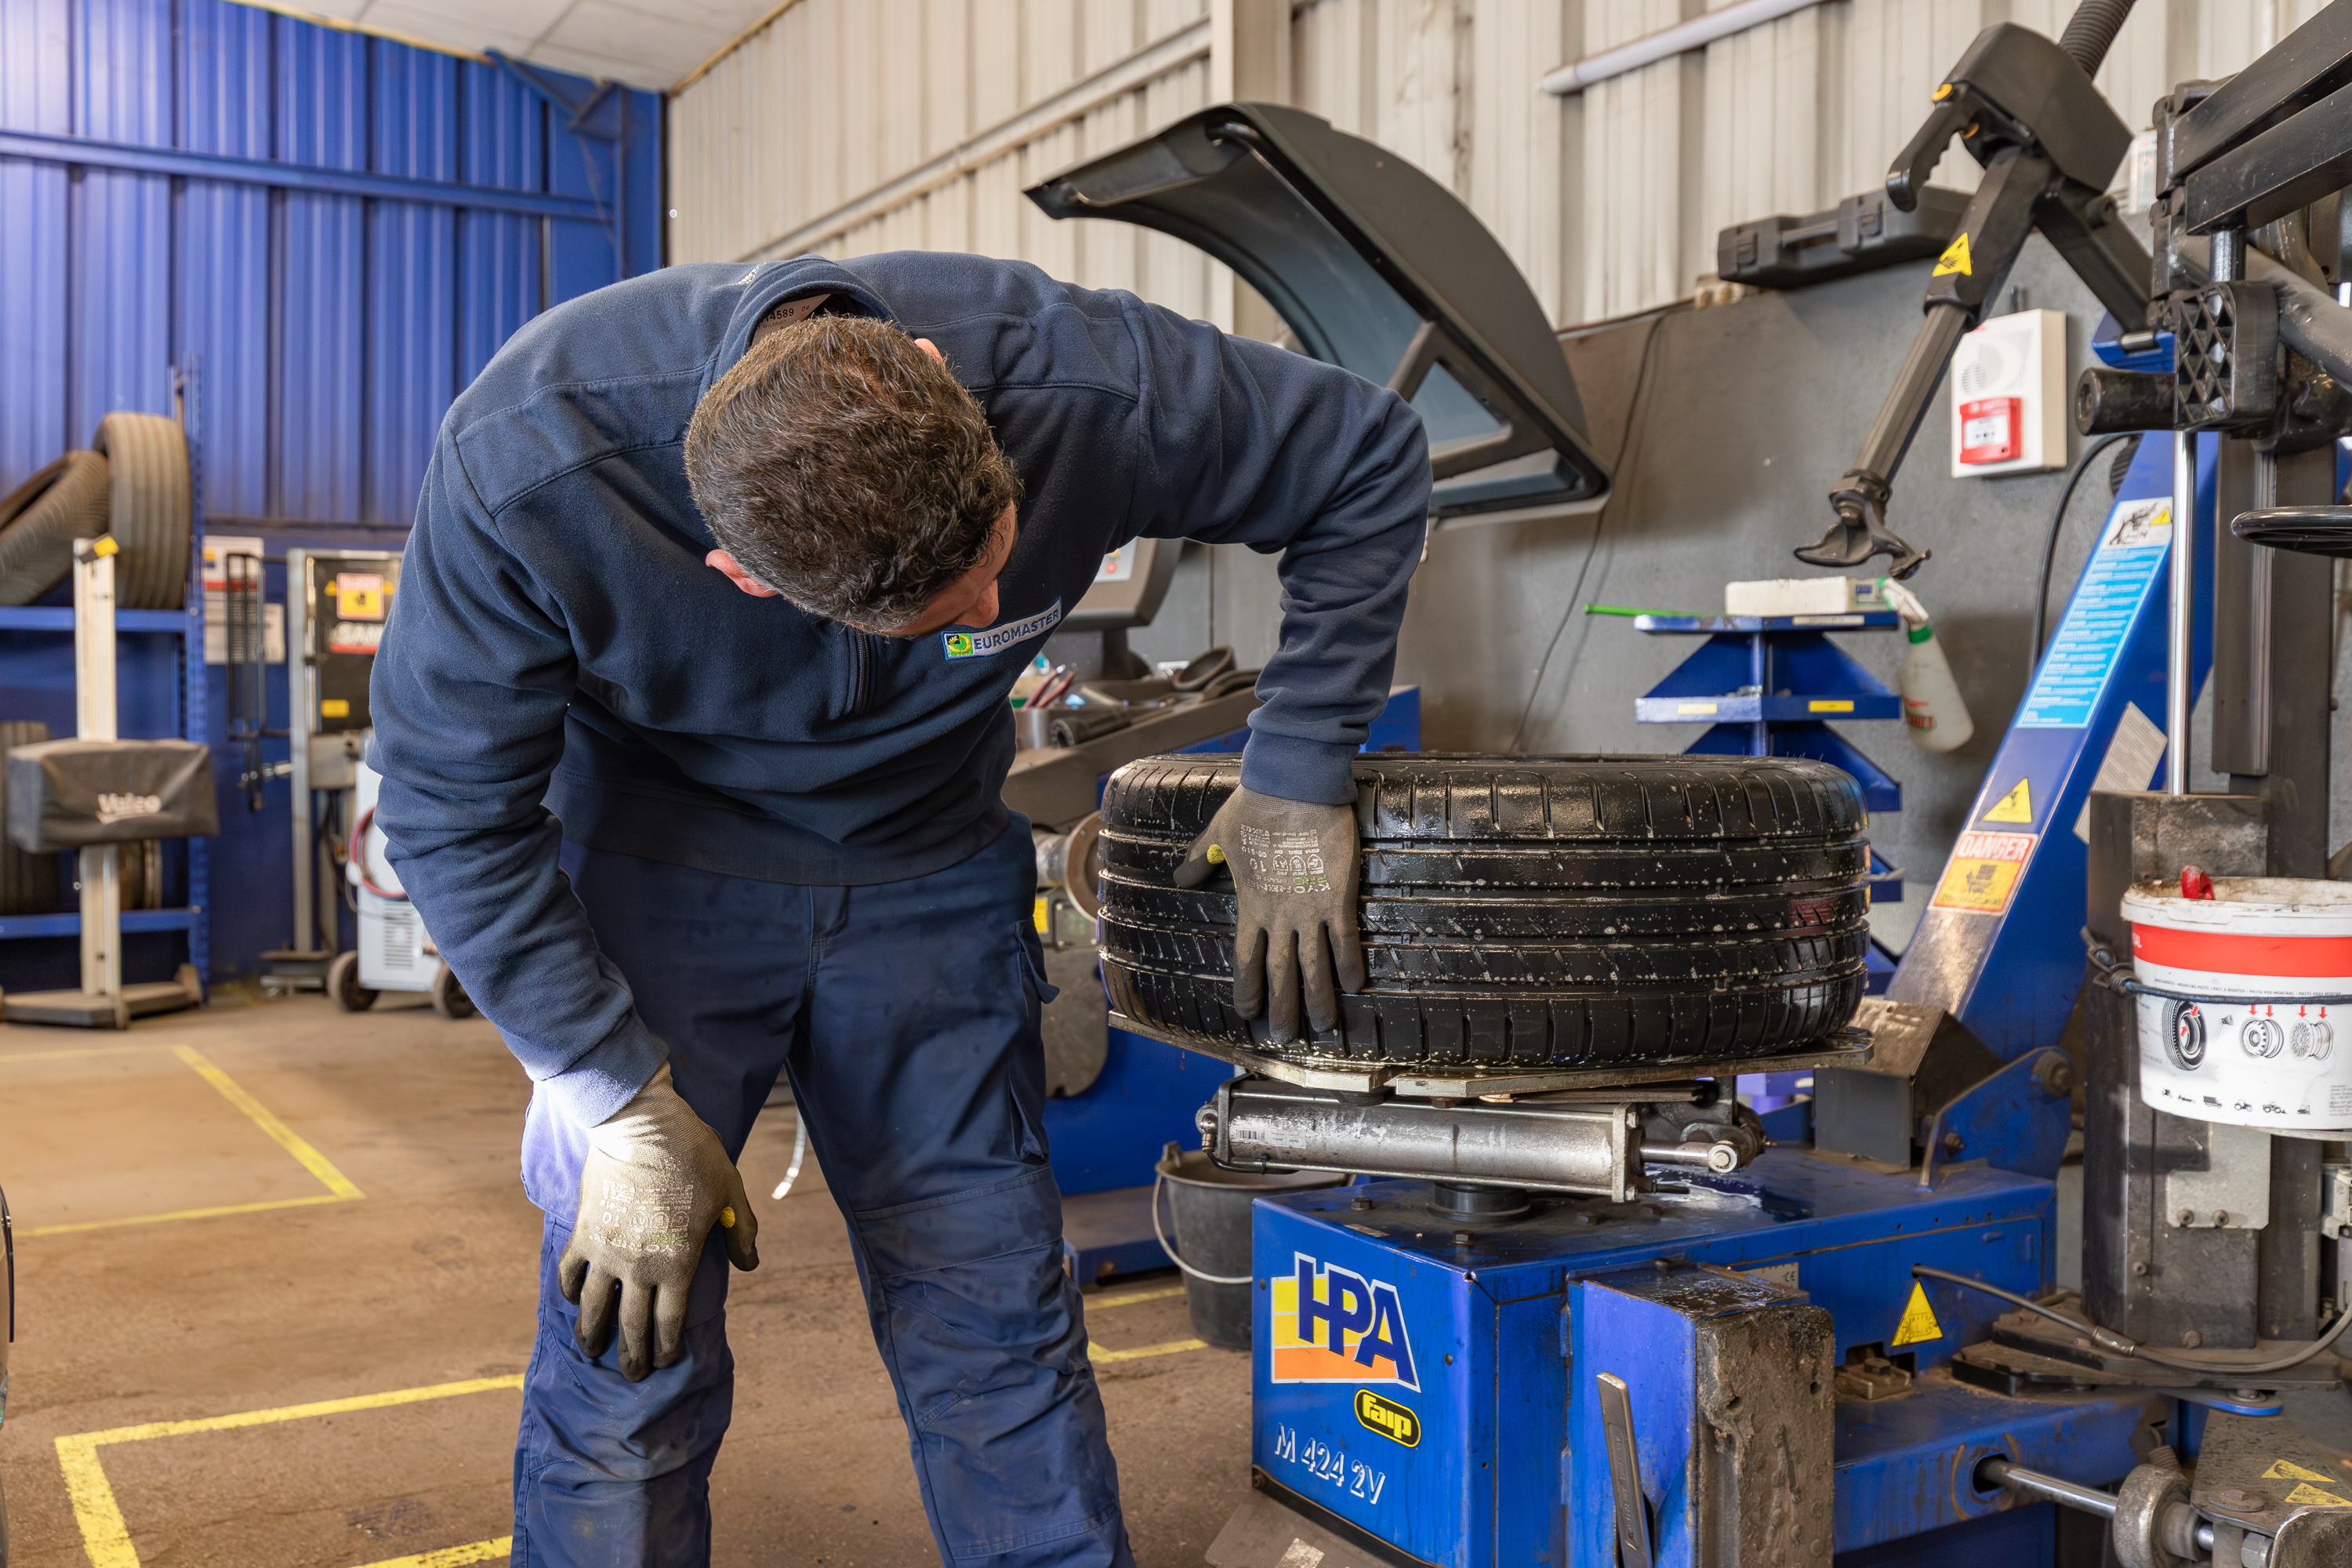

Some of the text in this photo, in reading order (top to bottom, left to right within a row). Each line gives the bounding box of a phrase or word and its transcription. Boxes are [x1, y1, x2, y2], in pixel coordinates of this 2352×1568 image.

[760, 307, 794, 322] 14589
[973, 608, 1059, 650] EUROMASTER
[1958, 835, 2030, 861] DANGER
[1296, 1254, 1419, 1390] HPA
[1273, 1421, 1387, 1505] M 424 2V
